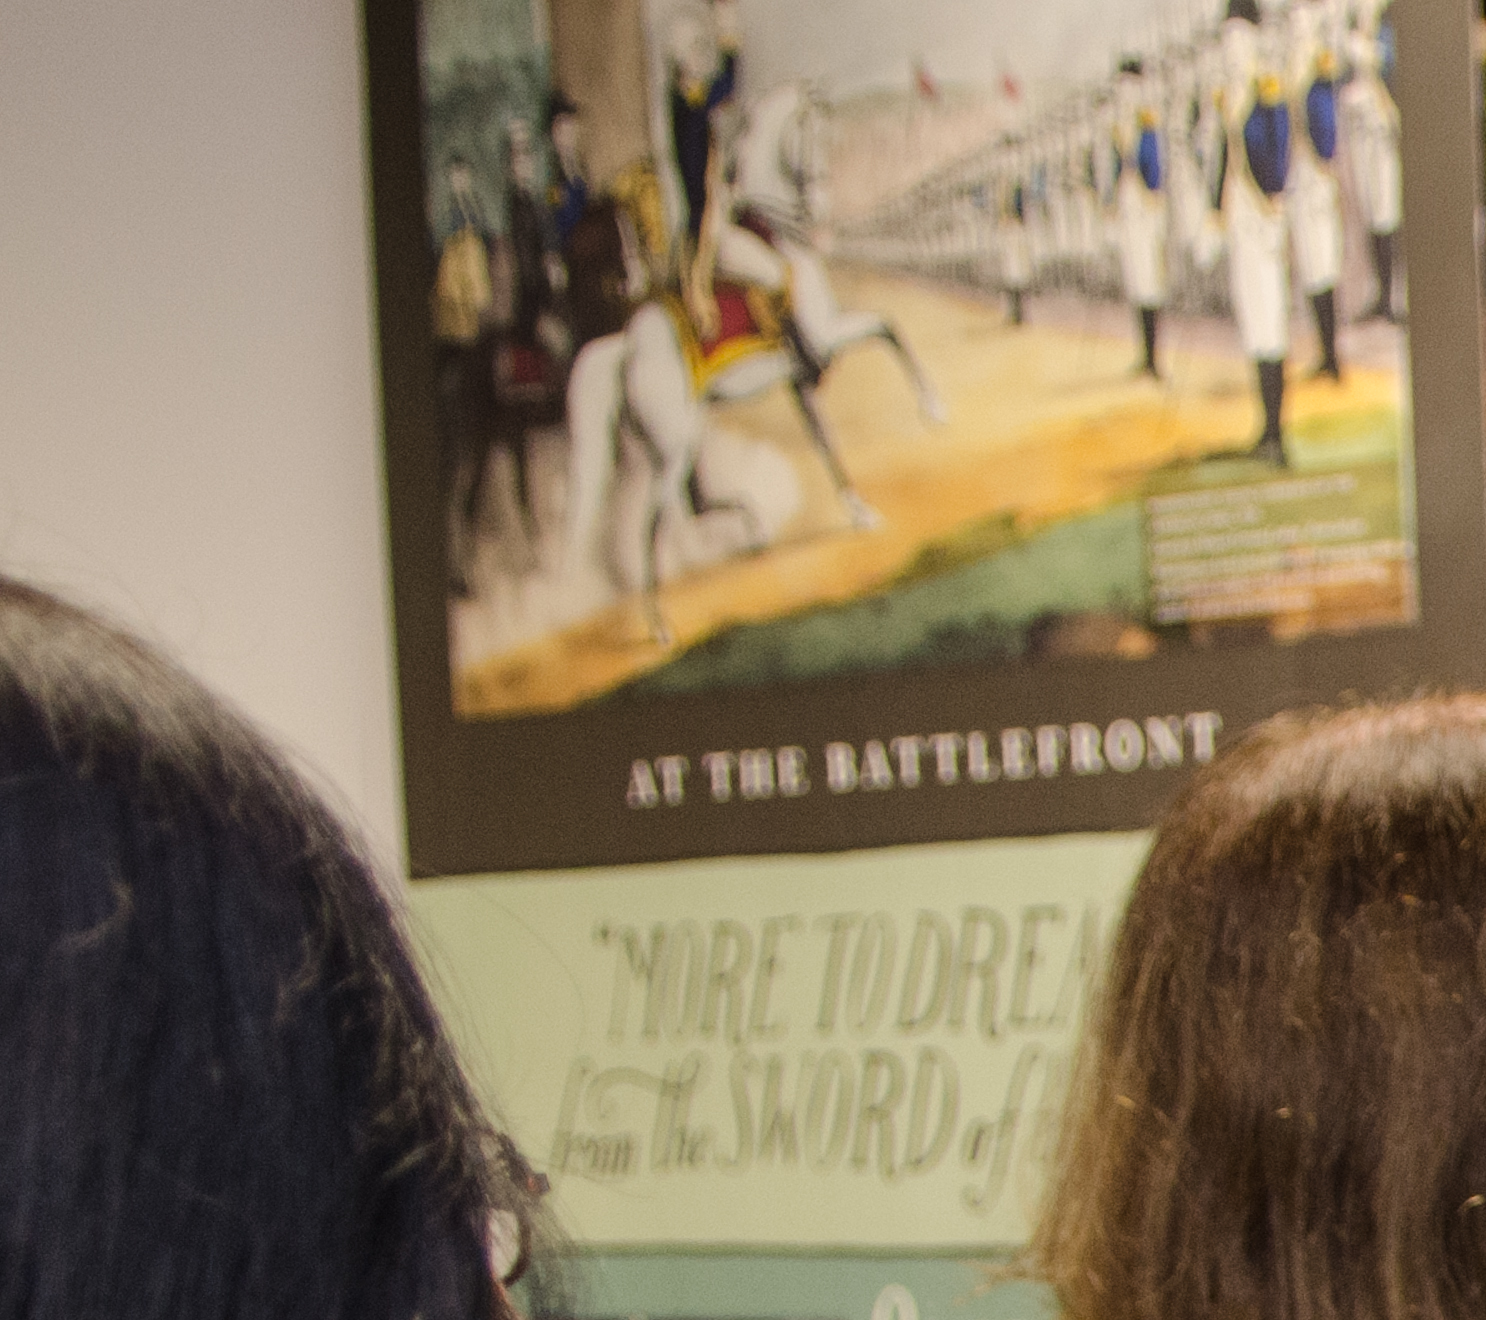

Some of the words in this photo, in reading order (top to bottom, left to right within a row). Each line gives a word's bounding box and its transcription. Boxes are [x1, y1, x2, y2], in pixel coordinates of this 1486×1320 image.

[626, 753, 690, 808] AT
[700, 744, 808, 802] THE
[824, 710, 1223, 794] BATTLEFRONT
[811, 908, 900, 1037] TO
[710, 1044, 961, 1185] SWORD
